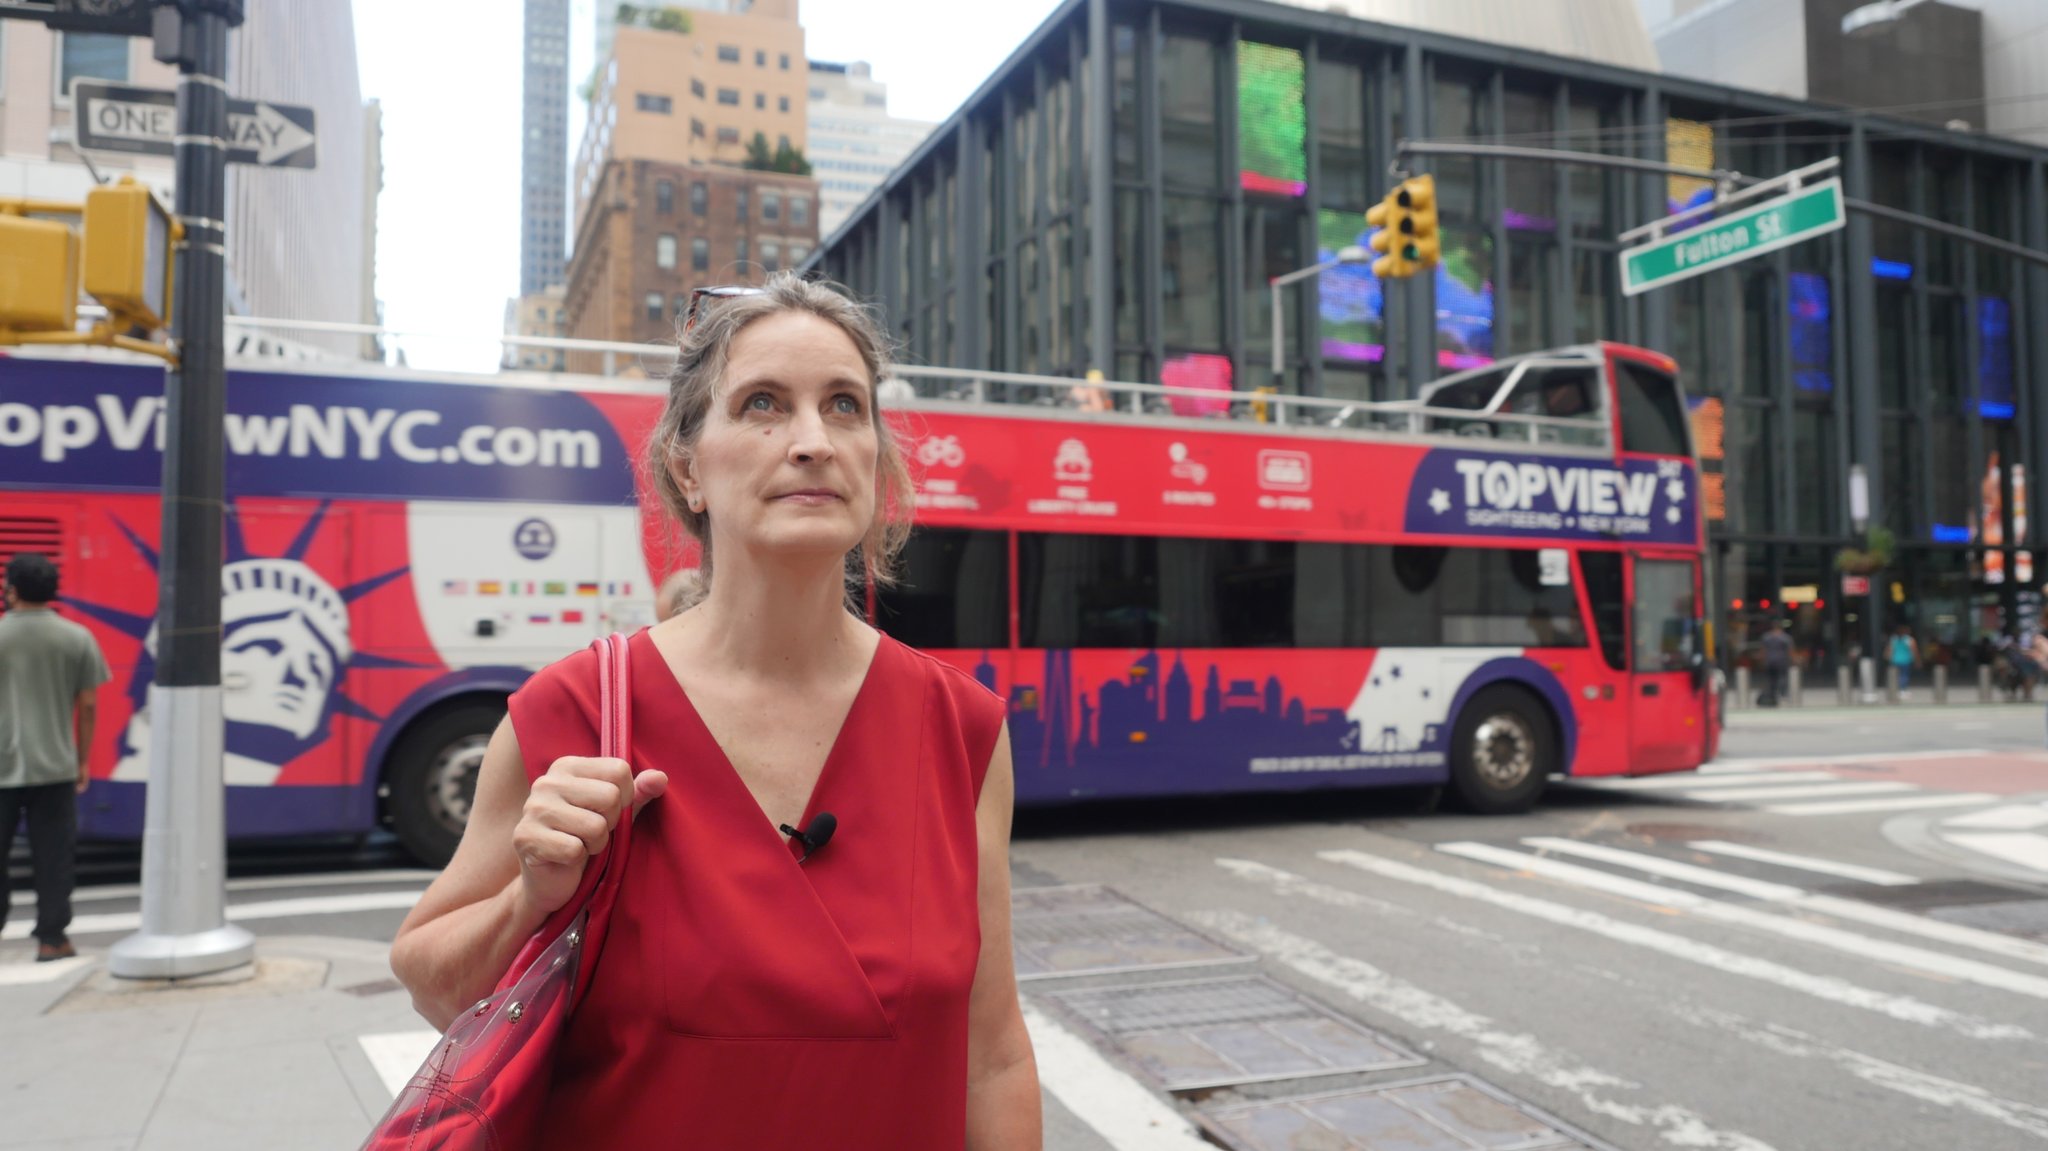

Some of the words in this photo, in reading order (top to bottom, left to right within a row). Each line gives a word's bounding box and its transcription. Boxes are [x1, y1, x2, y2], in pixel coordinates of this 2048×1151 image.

[98, 103, 171, 135] ONE
[1675, 226, 1749, 268] Fulton
[1755, 210, 1781, 241] St
[1456, 459, 1658, 517] TOPVIEW
[1467, 509, 1562, 530] SIGHTSEEING
[1578, 515, 1610, 532] NEW
[1613, 517, 1650, 534] YORK
